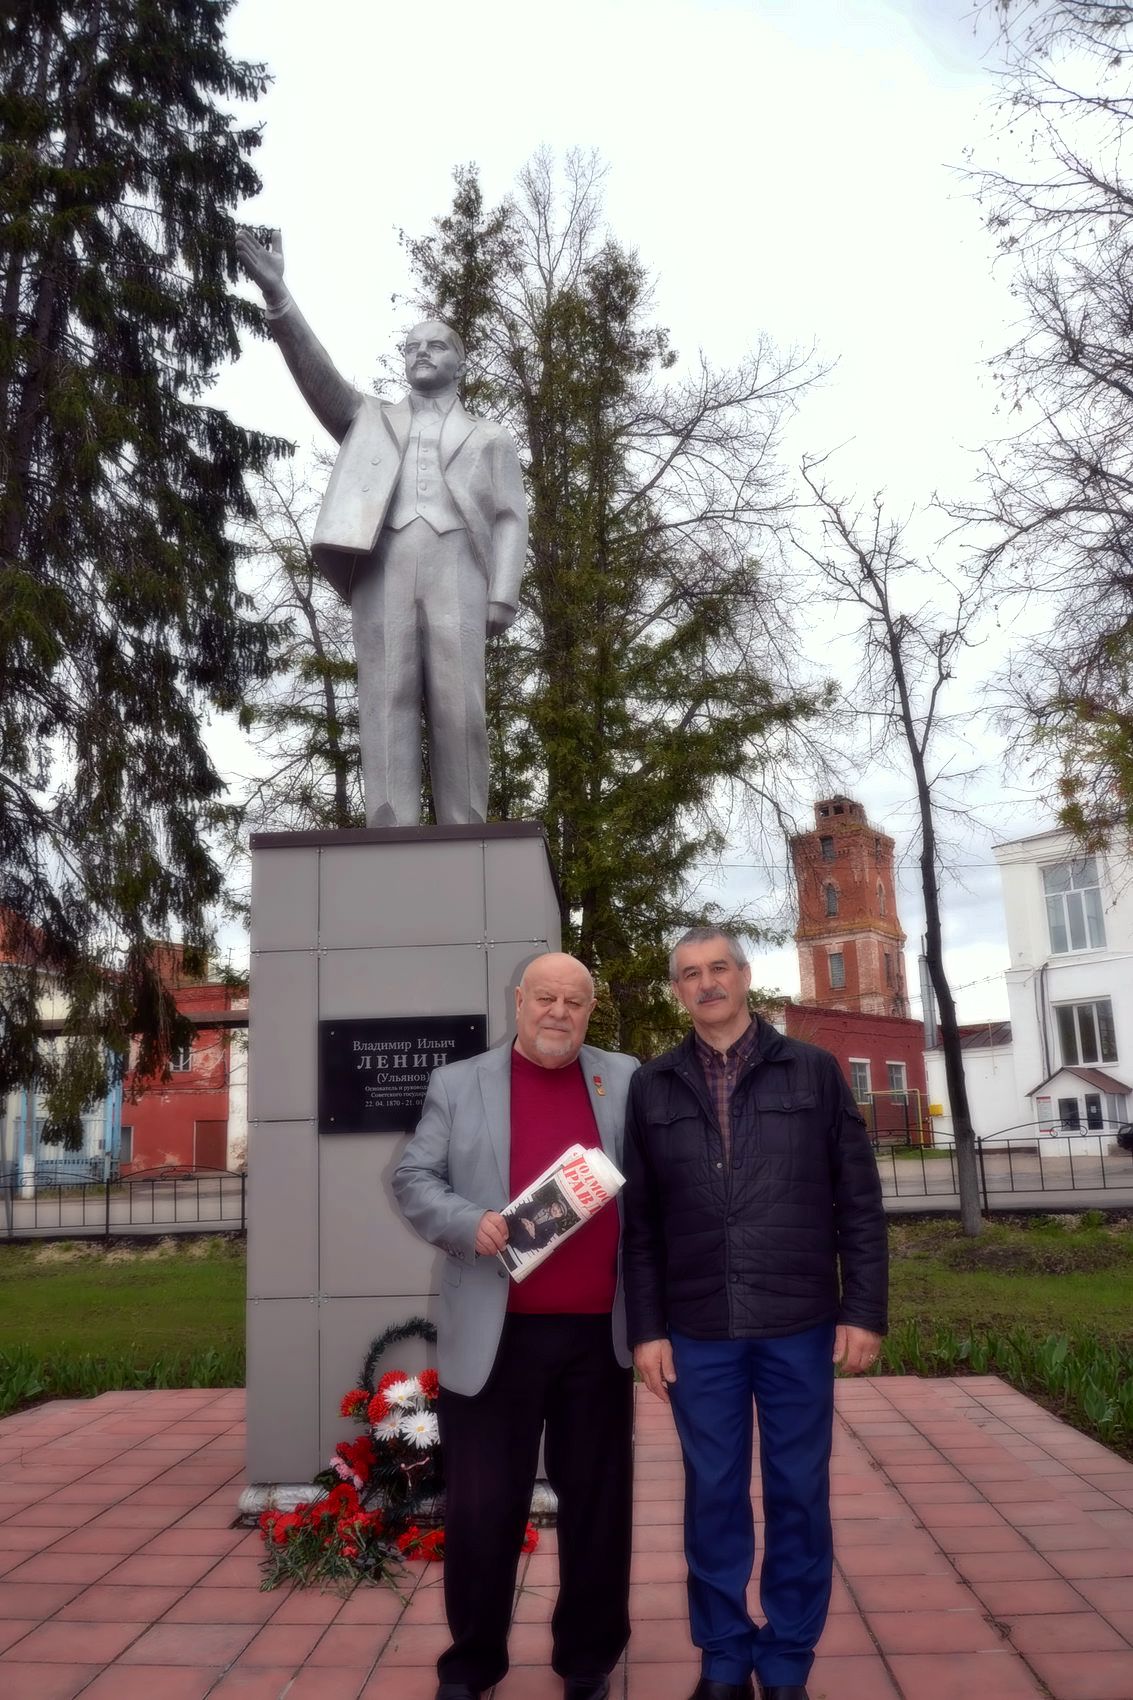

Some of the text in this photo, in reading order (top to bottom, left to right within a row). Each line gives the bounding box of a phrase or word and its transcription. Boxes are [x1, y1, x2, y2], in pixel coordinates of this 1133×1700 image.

[353, 1038, 456, 1052] Владимир Ильич
[357, 1053, 448, 1070] ЛЕНИН
[377, 1071, 430, 1084] (Ульянов)
